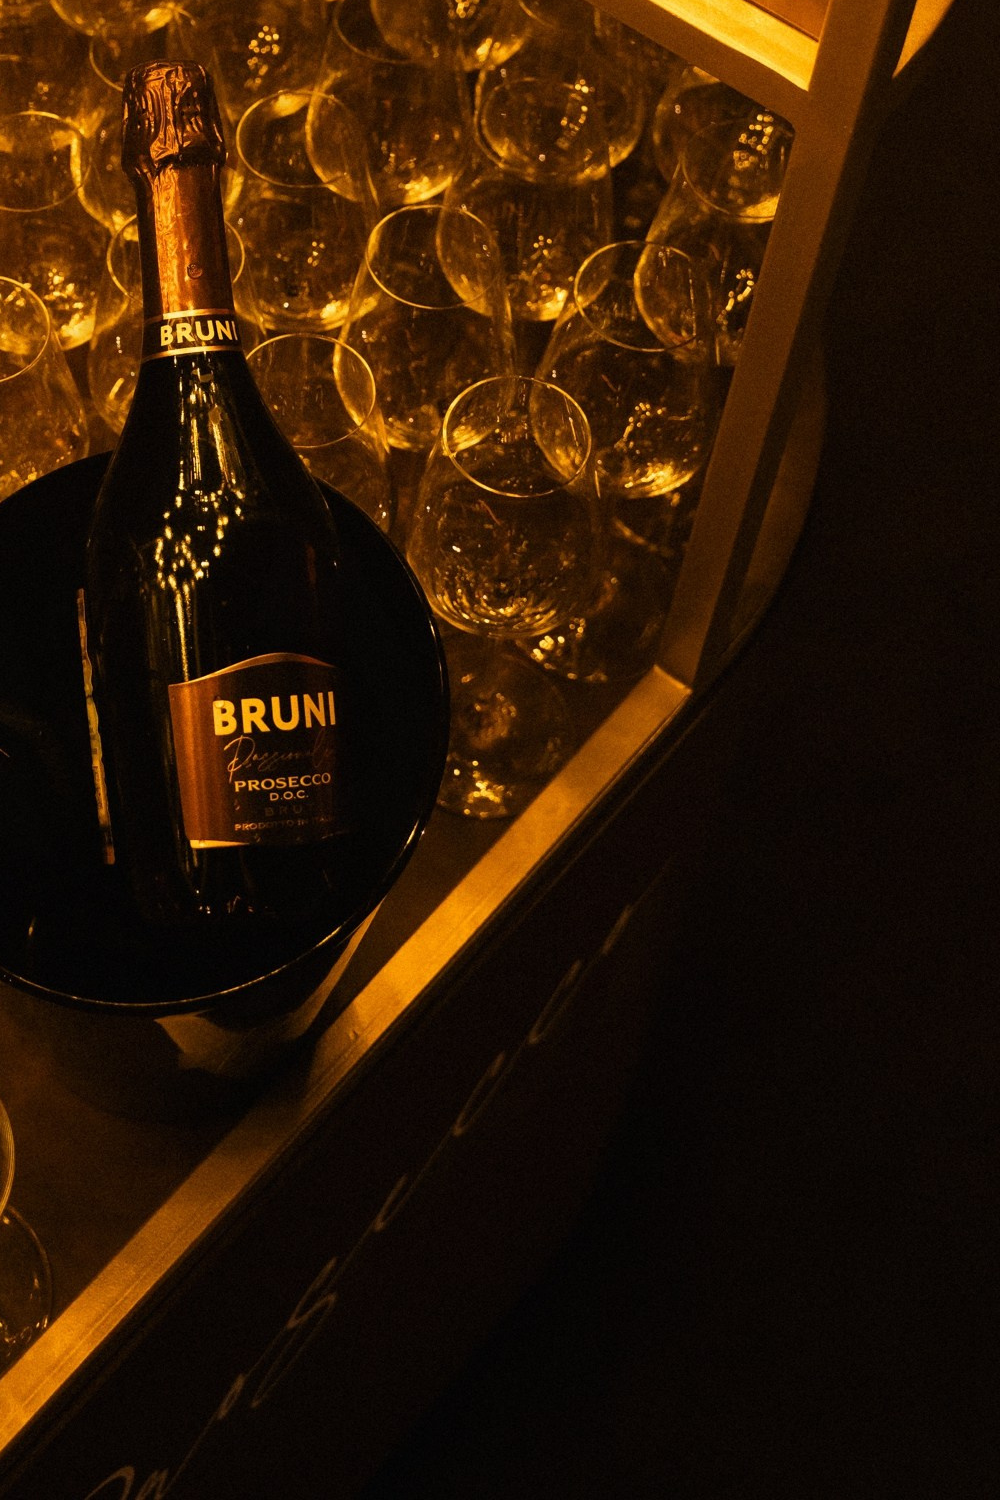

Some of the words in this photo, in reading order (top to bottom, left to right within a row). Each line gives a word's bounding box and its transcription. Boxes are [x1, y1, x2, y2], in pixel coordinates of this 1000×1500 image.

[160, 320, 239, 347] BRUNI
[212, 691, 336, 736] BRUNI
[234, 772, 332, 793] PROSECCO
[269, 790, 309, 801] D.O.C.
